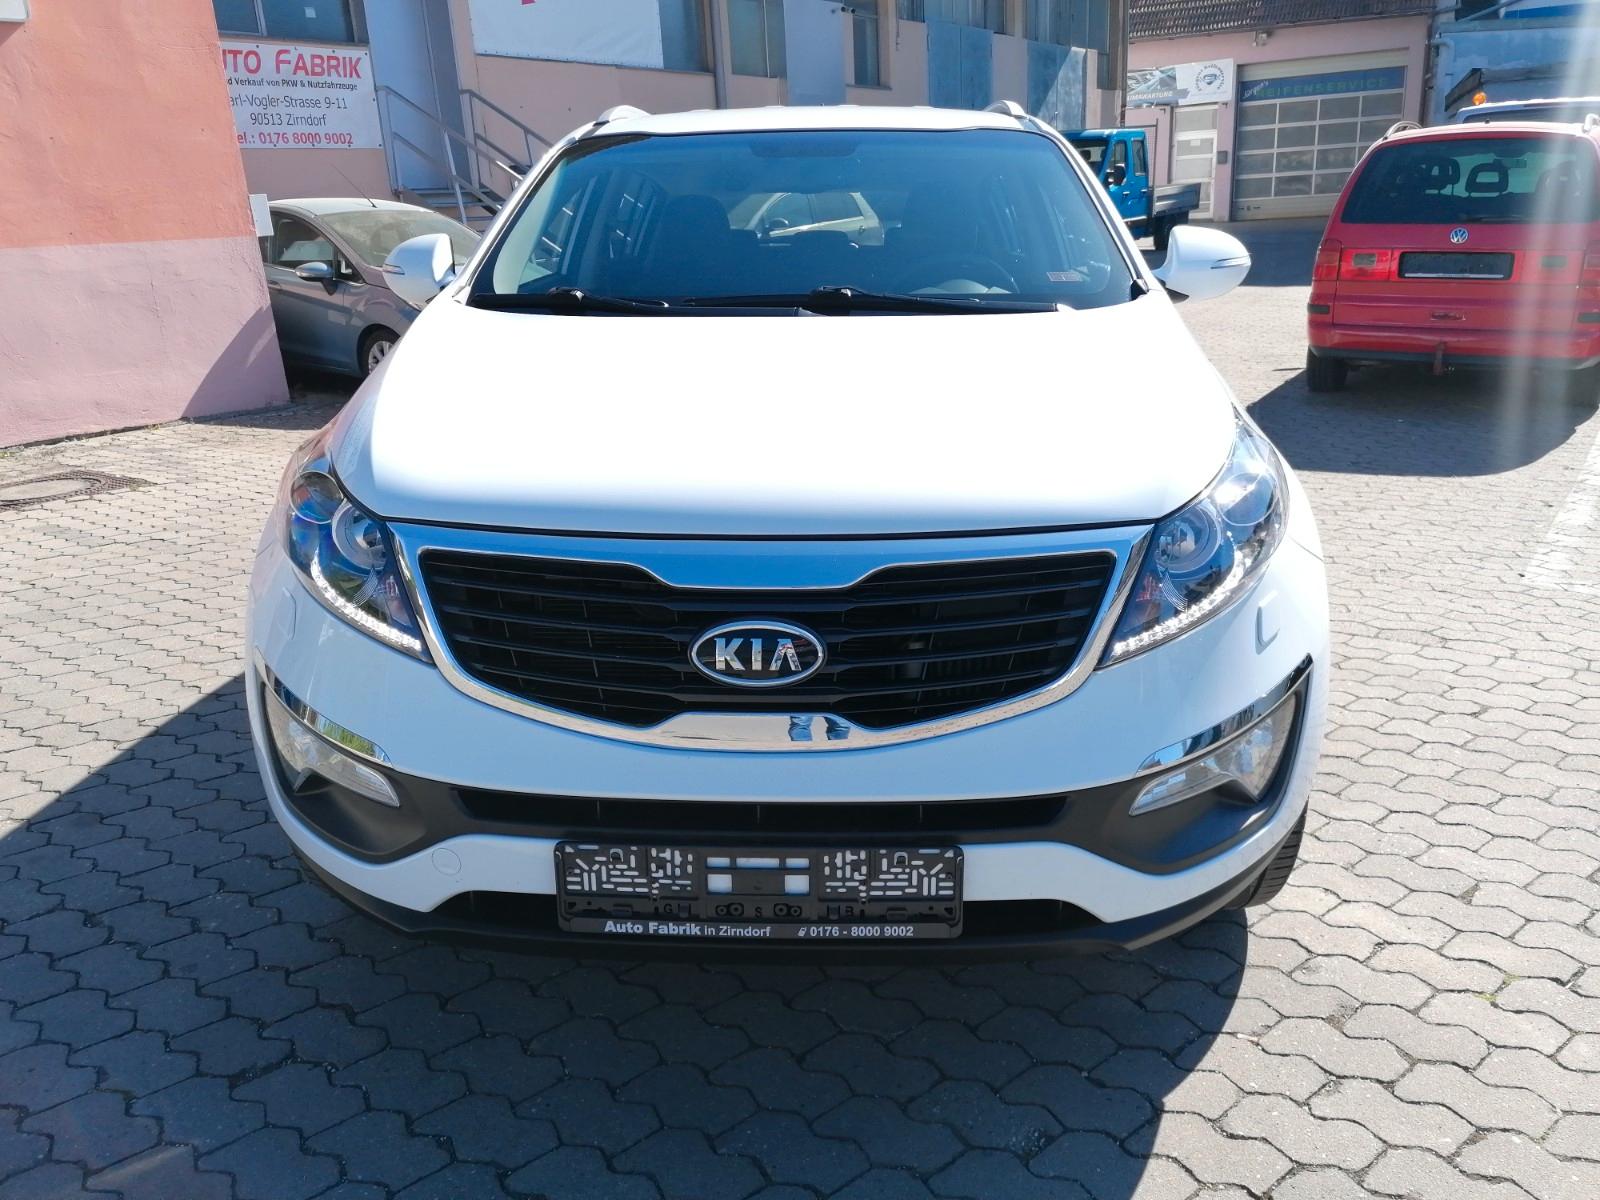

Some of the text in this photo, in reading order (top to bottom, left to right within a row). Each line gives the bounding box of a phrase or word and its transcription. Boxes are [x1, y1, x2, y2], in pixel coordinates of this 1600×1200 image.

[275, 50, 361, 79] FABRIK
[234, 77, 264, 87] Verkauf
[281, 79, 298, 88] PKW
[300, 80, 306, 88] &
[307, 81, 358, 92] Nutzfahrzeuge
[229, 93, 347, 110] arl-Vogler-Strasse 9-11
[250, 112, 327, 126] 90513 Zirndorf
[237, 132, 354, 145] el.: 0176 8000 9002
[714, 637, 802, 671] KIA
[604, 921, 643, 933] Auto
[649, 922, 701, 935] Fabrik
[718, 926, 771, 937] Zirndorf
[810, 926, 840, 937] 0176
[851, 926, 880, 937] 8000
[884, 926, 914, 937] 9002
